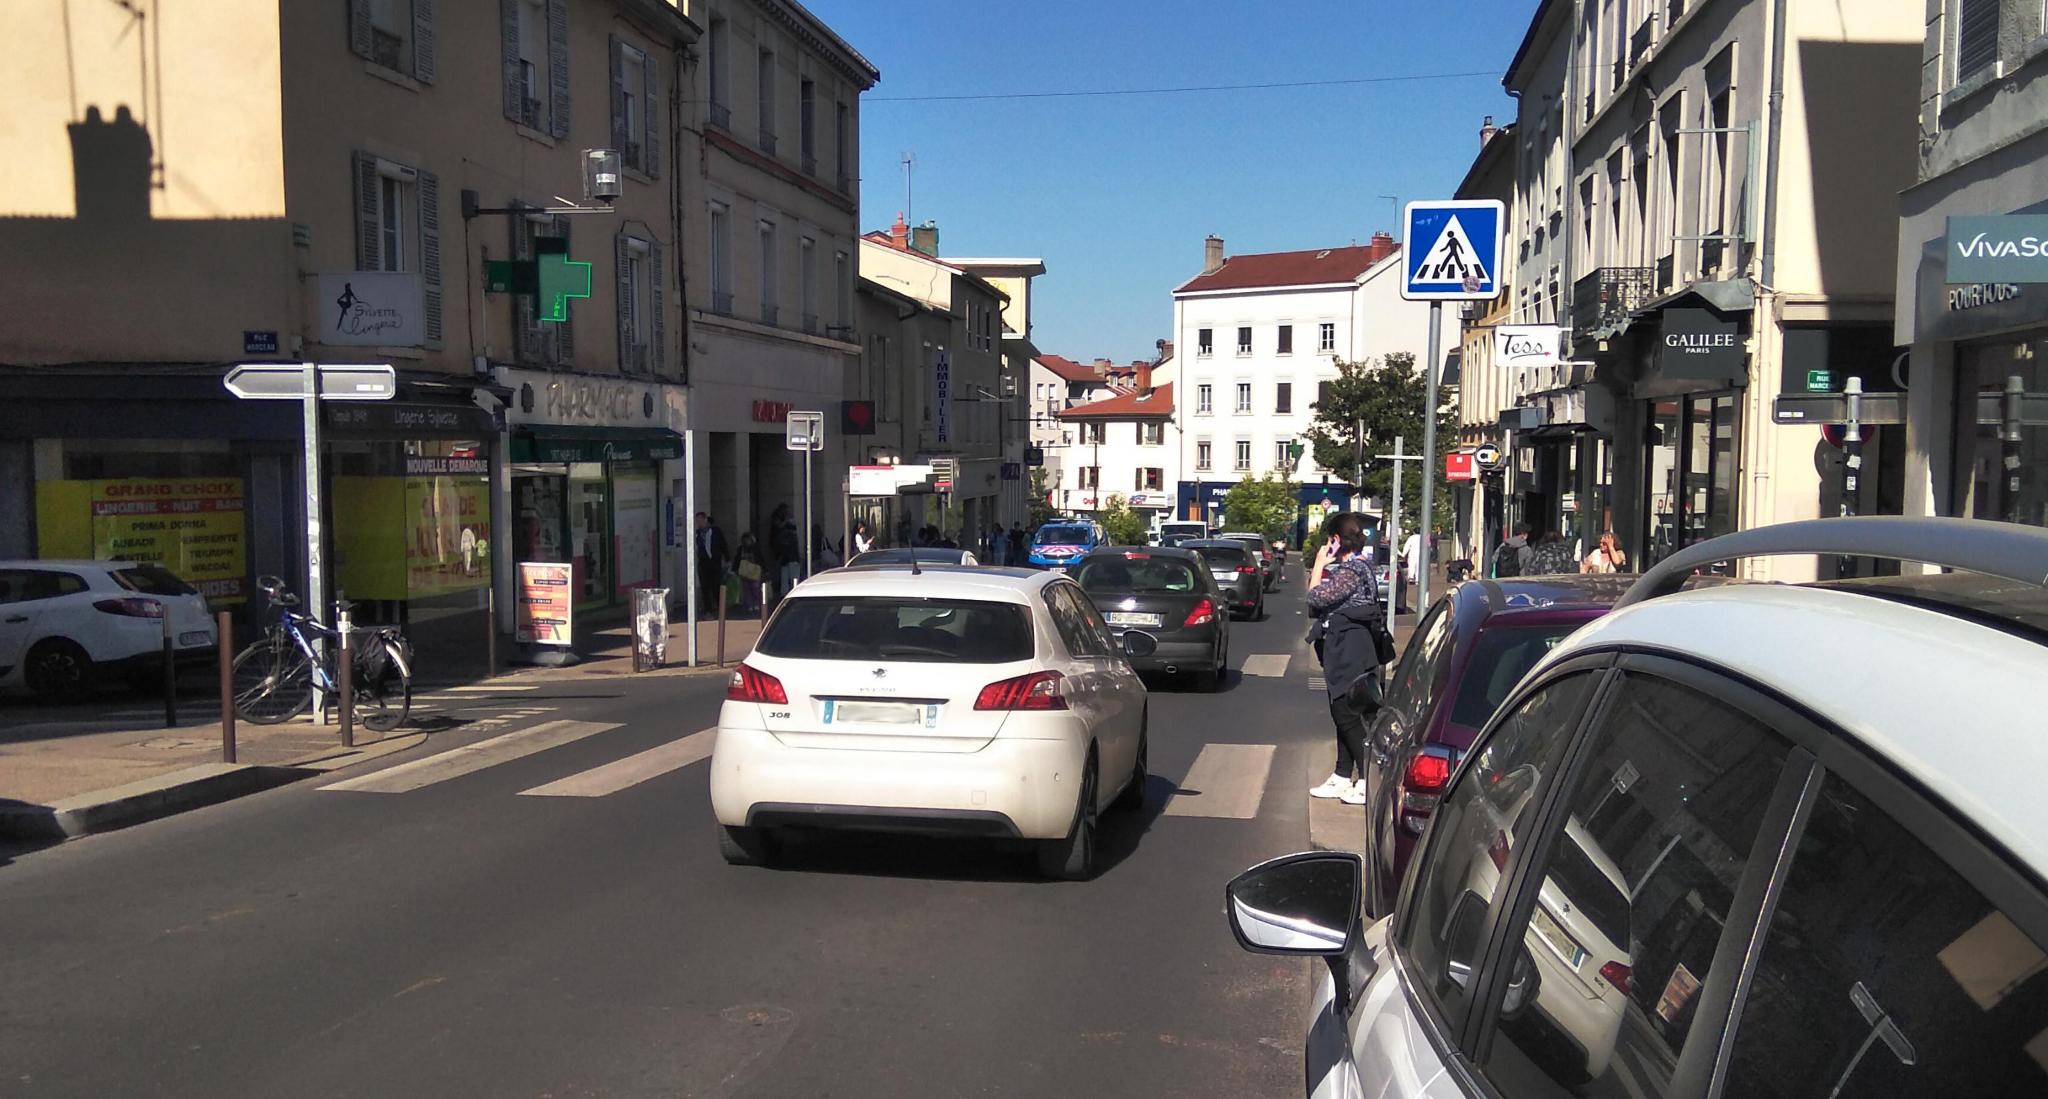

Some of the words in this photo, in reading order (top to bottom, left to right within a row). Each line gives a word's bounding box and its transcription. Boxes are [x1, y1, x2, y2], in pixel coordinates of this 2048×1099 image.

[1948, 285, 1980, 311] POUR
[1982, 283, 2013, 305] TOUS
[1500, 333, 1543, 355] Tess
[1665, 333, 1734, 347] GALILEE
[936, 353, 948, 443] IMMOBILIER
[407, 459, 447, 473] NOUVELLE
[449, 459, 488, 473] DEMARQUE
[105, 484, 171, 496] GRAND
[179, 483, 235, 495] CHOIX
[96, 502, 159, 513] LINGERIE
[172, 500, 200, 511] NUIT
[131, 521, 166, 531] PRIMA
[170, 519, 207, 530] DONNA
[769, 711, 791, 719] 308
